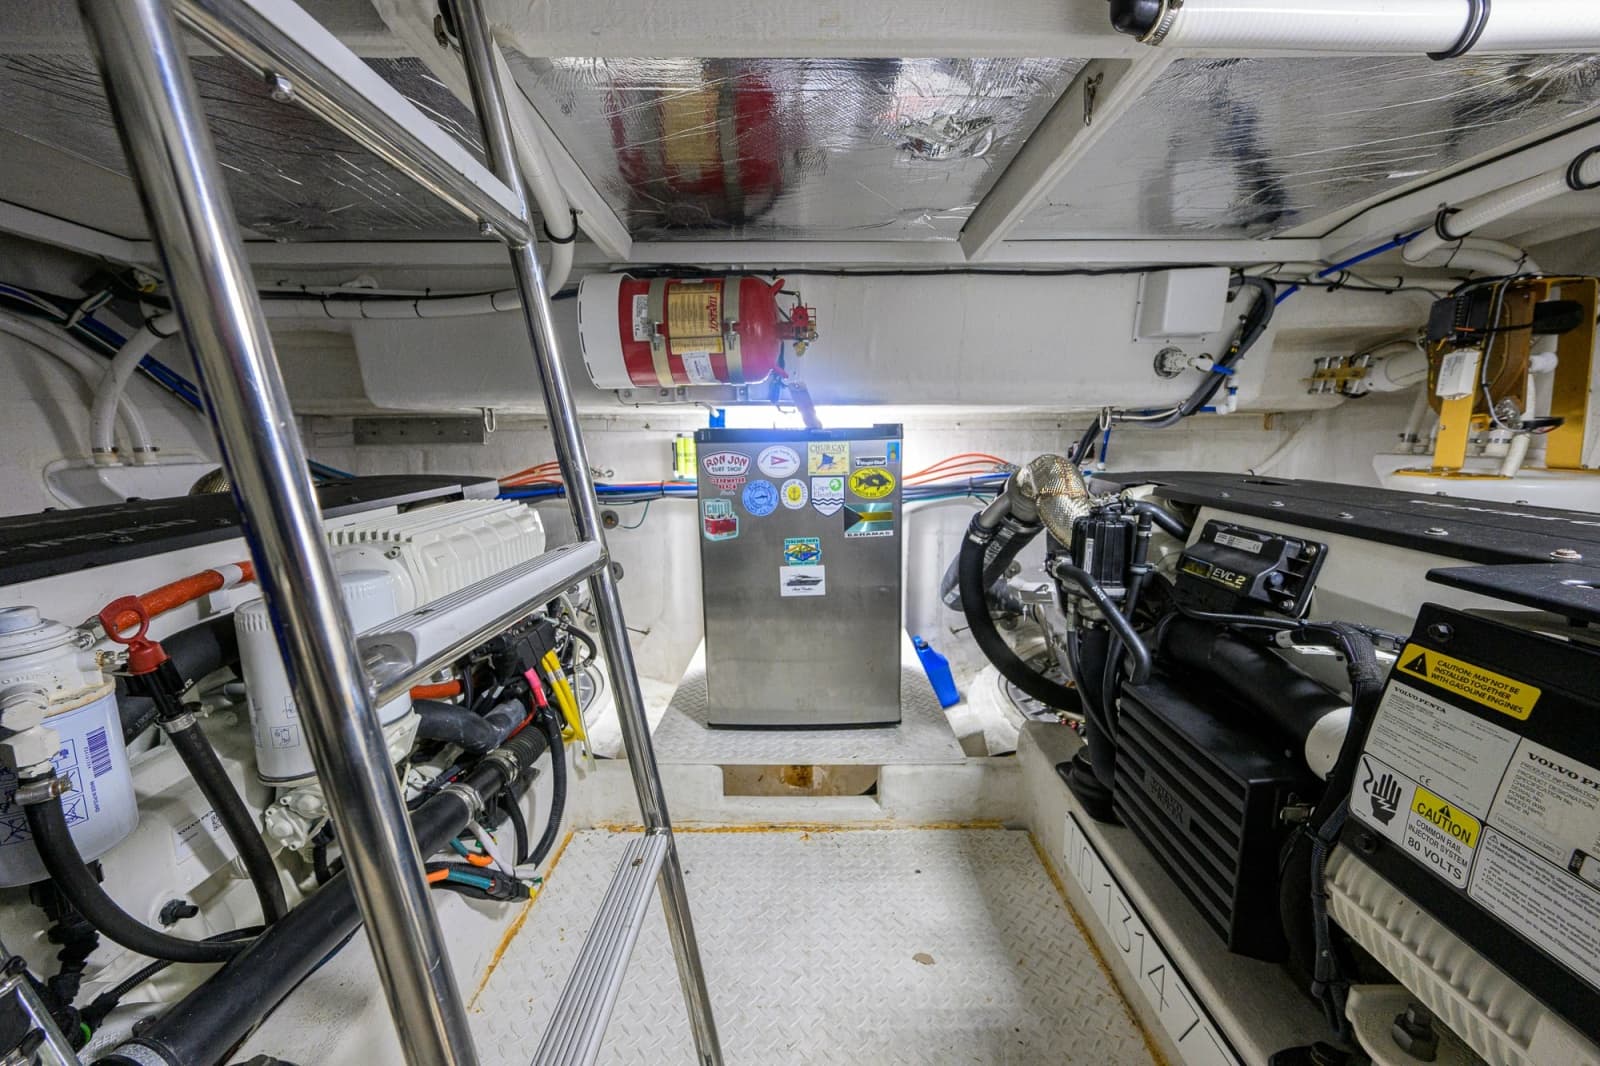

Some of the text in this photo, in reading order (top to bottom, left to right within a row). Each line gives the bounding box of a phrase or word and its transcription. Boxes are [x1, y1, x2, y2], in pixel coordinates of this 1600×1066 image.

[706, 455, 726, 468] RON
[728, 456, 748, 466] JON
[1212, 568, 1236, 582] EVC
[1235, 576, 1246, 586] 2
[1431, 673, 1524, 714] WITH GASOLINE ENGINES
[1434, 666, 1512, 700] INSTALLED TOGETHER
[1437, 660, 1521, 695] CAUTION: MAY NOT BE
[1394, 686, 1420, 701] VOLVO
[1420, 698, 1446, 714] PENTA
[1528, 752, 1579, 780] VOLVO
[1416, 820, 1462, 854] COMMON RAIL
[1417, 802, 1472, 844] CAUTION
[1408, 824, 1468, 867] INJECTOR SYSTEM
[1408, 836, 1462, 880] 80 VOLTS
[1103, 882, 1233, 1066] 13147
